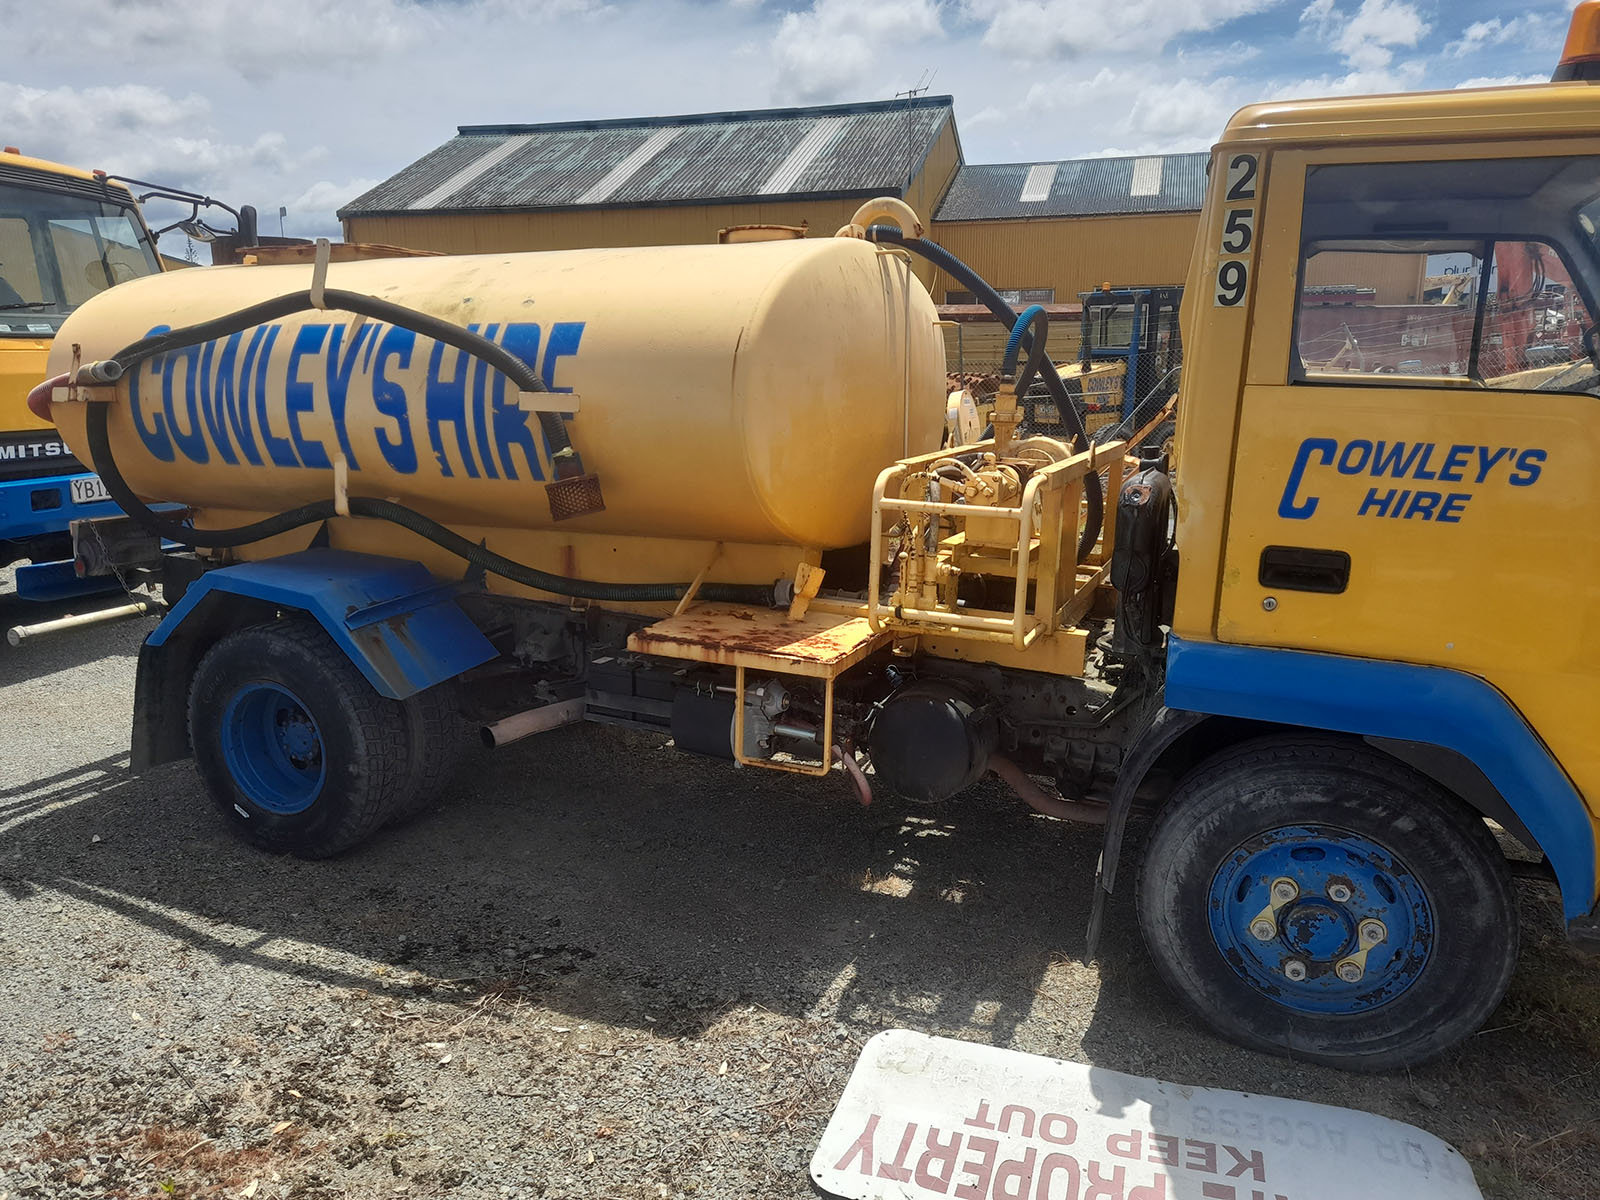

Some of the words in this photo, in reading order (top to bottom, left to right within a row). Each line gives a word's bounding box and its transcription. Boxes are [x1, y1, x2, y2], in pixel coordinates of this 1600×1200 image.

[129, 323, 419, 476] COWLEY'S
[73, 479, 112, 500] YB1
[1277, 437, 1548, 520] COWLEY'S
[1357, 487, 1473, 523] HIRE
[963, 1097, 1078, 1146] OUT
[1106, 1129, 1266, 1182] KEEP
